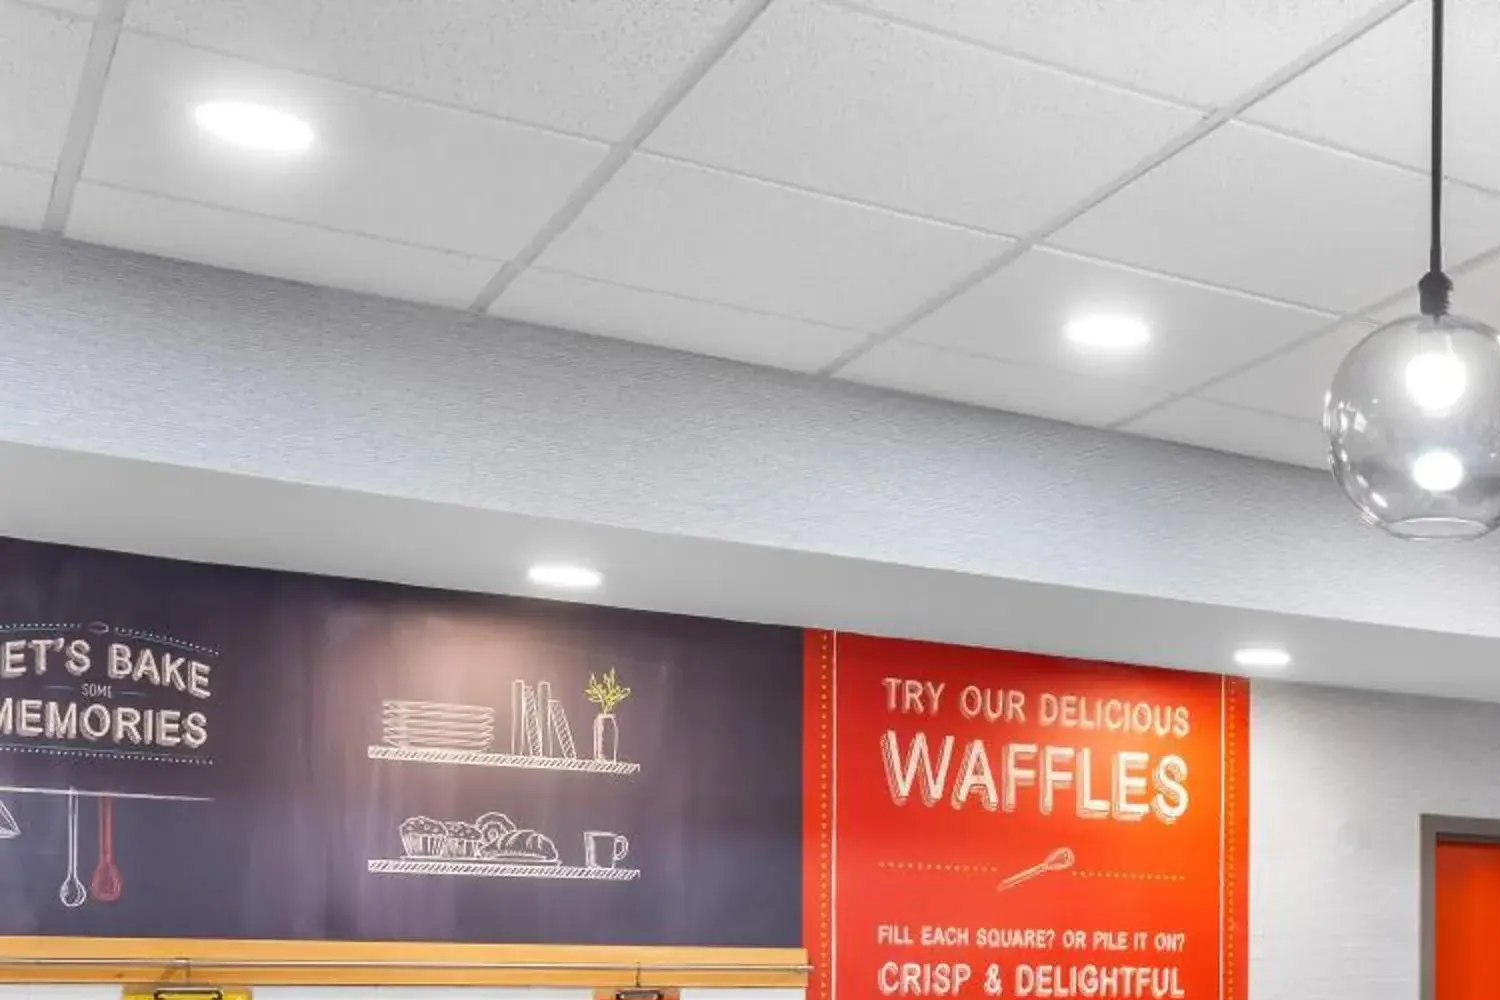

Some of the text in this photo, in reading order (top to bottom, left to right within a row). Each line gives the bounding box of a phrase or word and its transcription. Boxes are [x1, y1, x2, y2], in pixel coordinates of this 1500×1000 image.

[0, 637, 213, 699] ET'S BAKE
[81, 683, 113, 699] SOME
[883, 677, 1190, 739] TRY OUR DELICIOUS
[880, 730, 1190, 825] WAFFLES
[877, 925, 1185, 953] FILL EACH SQUARE? OR PILE IT ON?
[877, 961, 1185, 999] CRISP & DELIGHTFUL
